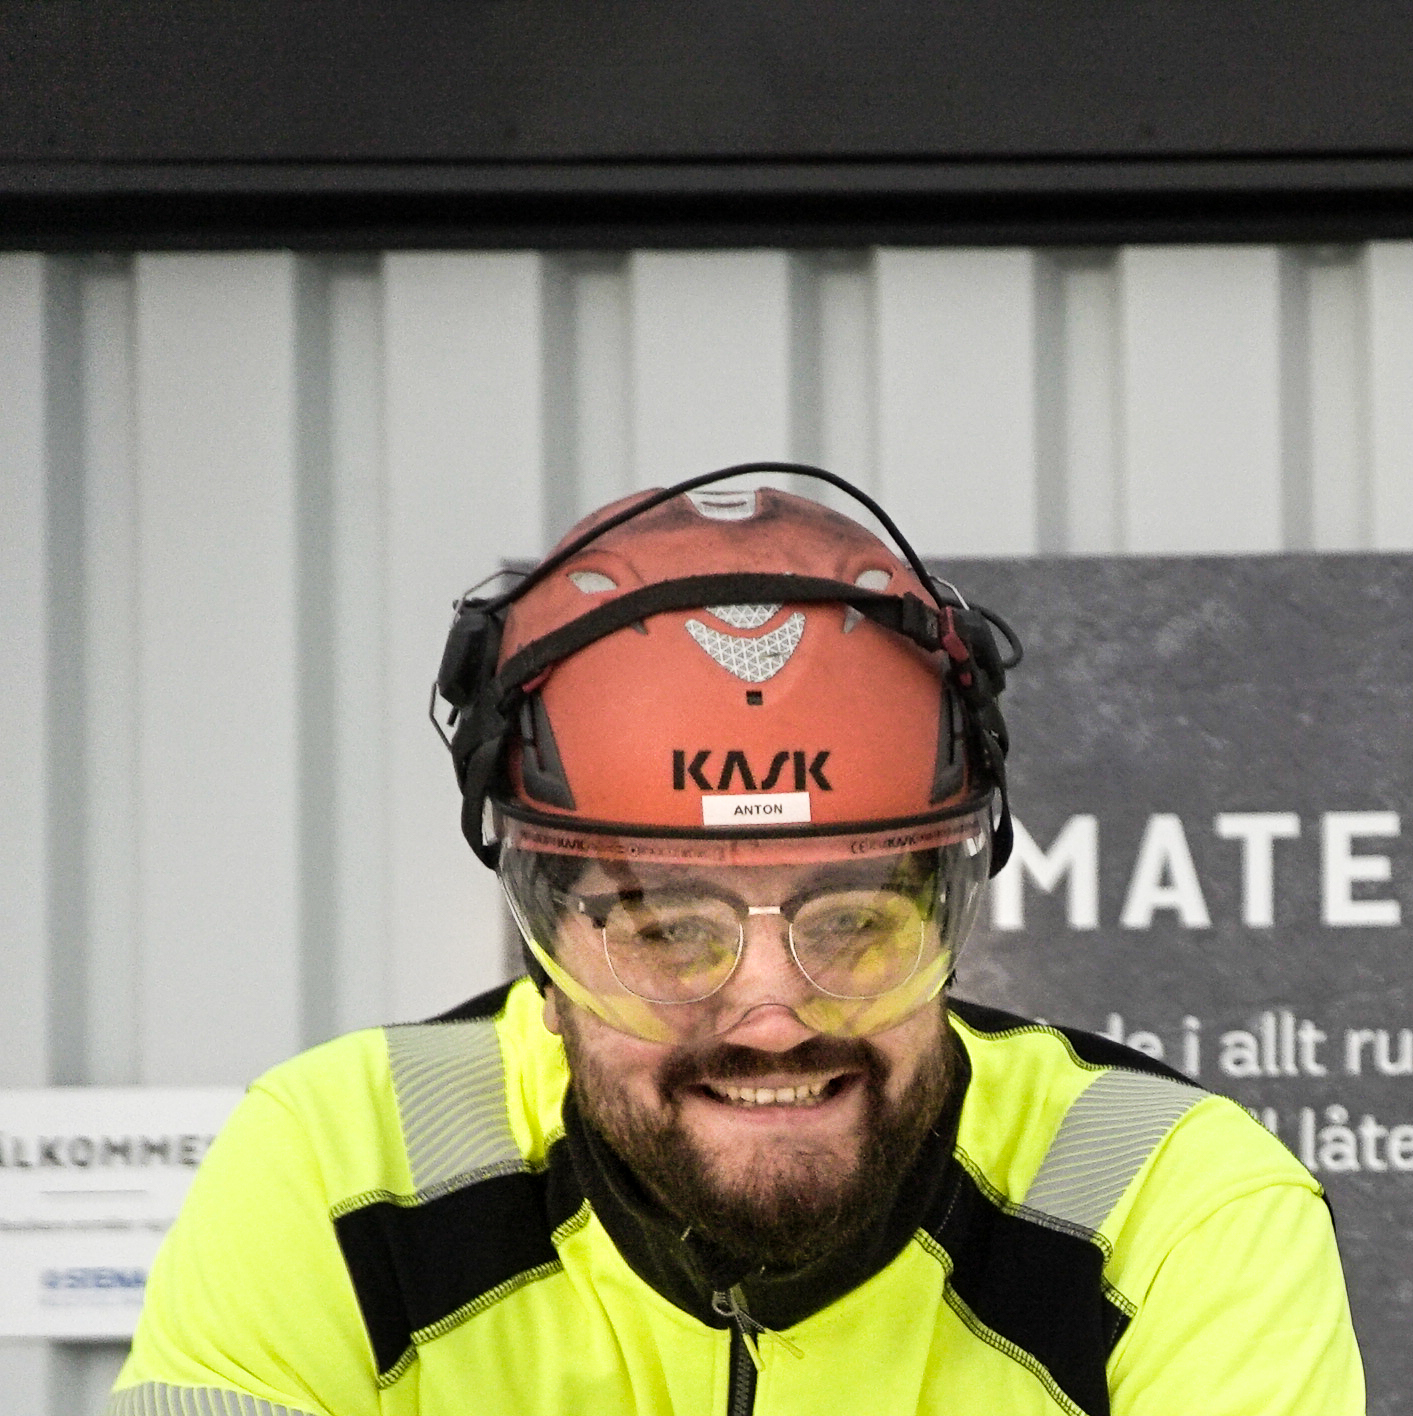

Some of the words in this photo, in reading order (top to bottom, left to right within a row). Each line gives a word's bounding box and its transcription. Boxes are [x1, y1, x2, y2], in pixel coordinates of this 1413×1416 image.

[673, 749, 832, 791] KASK
[734, 804, 783, 816] ANTON
[1183, 1014, 1201, 1077] i
[1218, 1009, 1327, 1078] allt
